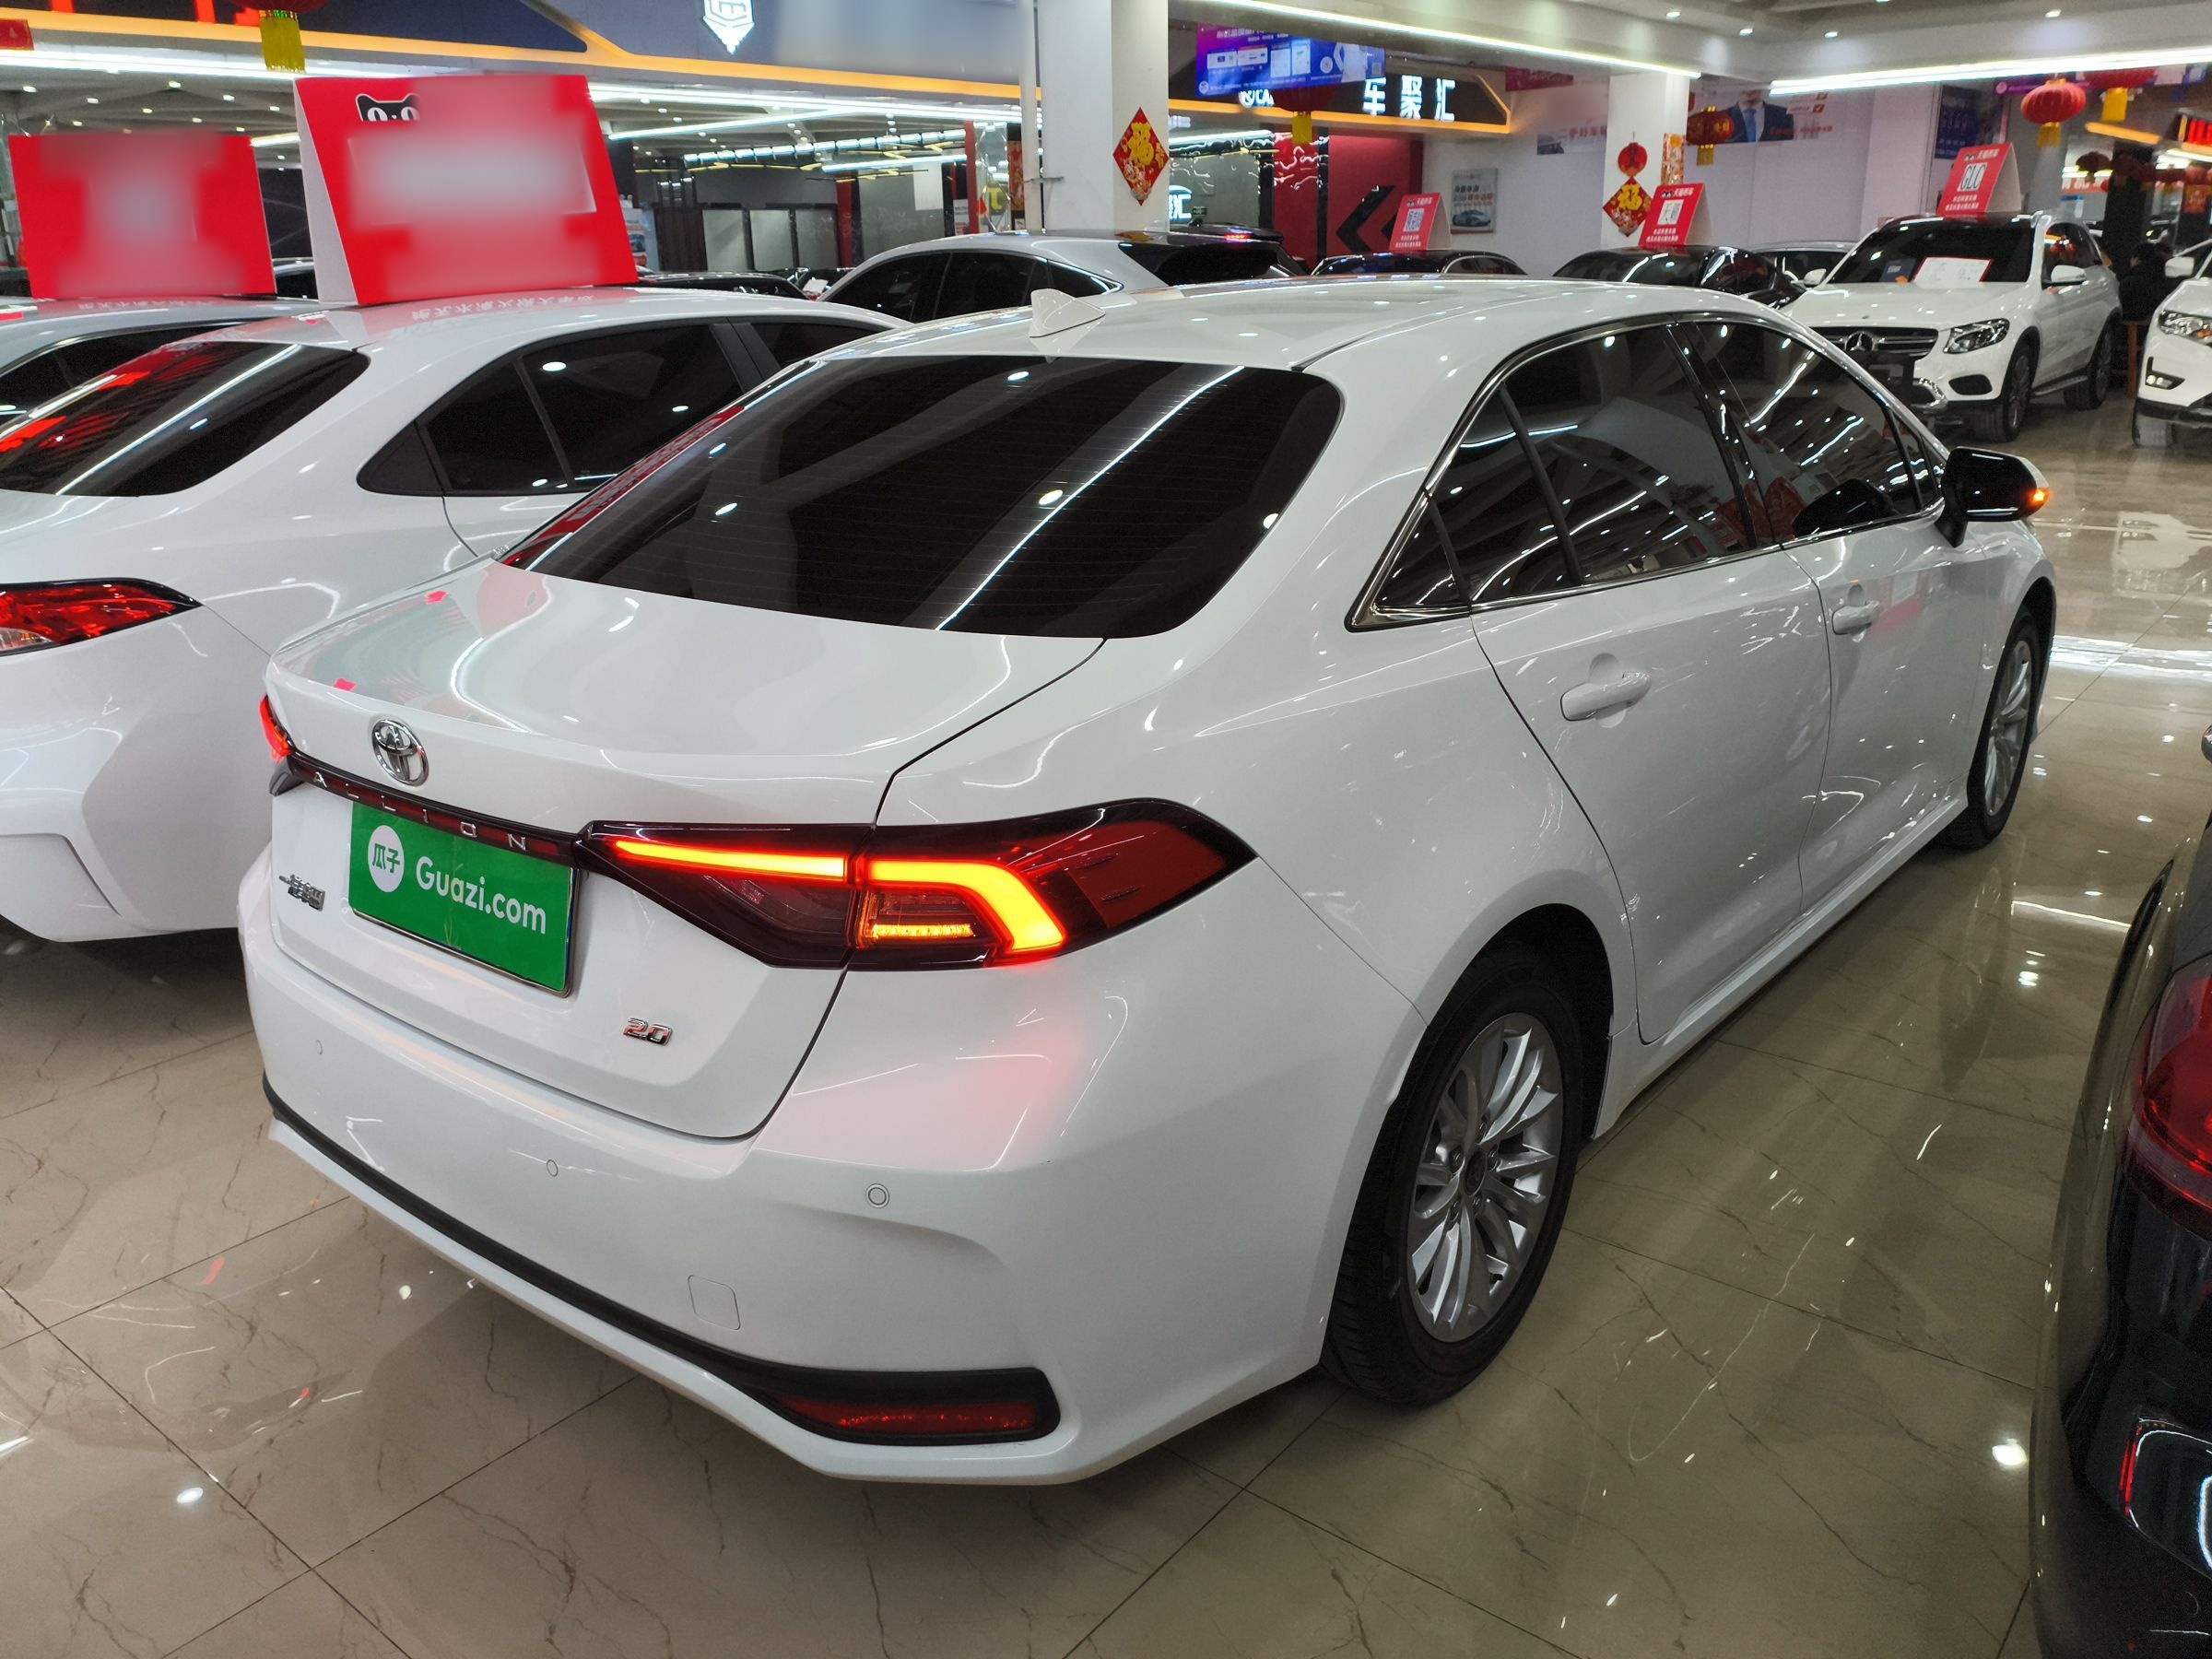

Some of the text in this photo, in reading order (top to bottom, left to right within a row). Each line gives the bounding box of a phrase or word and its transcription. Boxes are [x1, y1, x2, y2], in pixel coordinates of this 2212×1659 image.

[1362, 75, 1456, 122] 车聚汇
[1127, 122, 1154, 166] 福
[1959, 164, 1987, 190] GLC
[312, 771, 528, 853] ALLION
[371, 841, 401, 875] 瓜子
[416, 856, 547, 935] Guazi.com
[622, 1017, 674, 1046] 2.0
